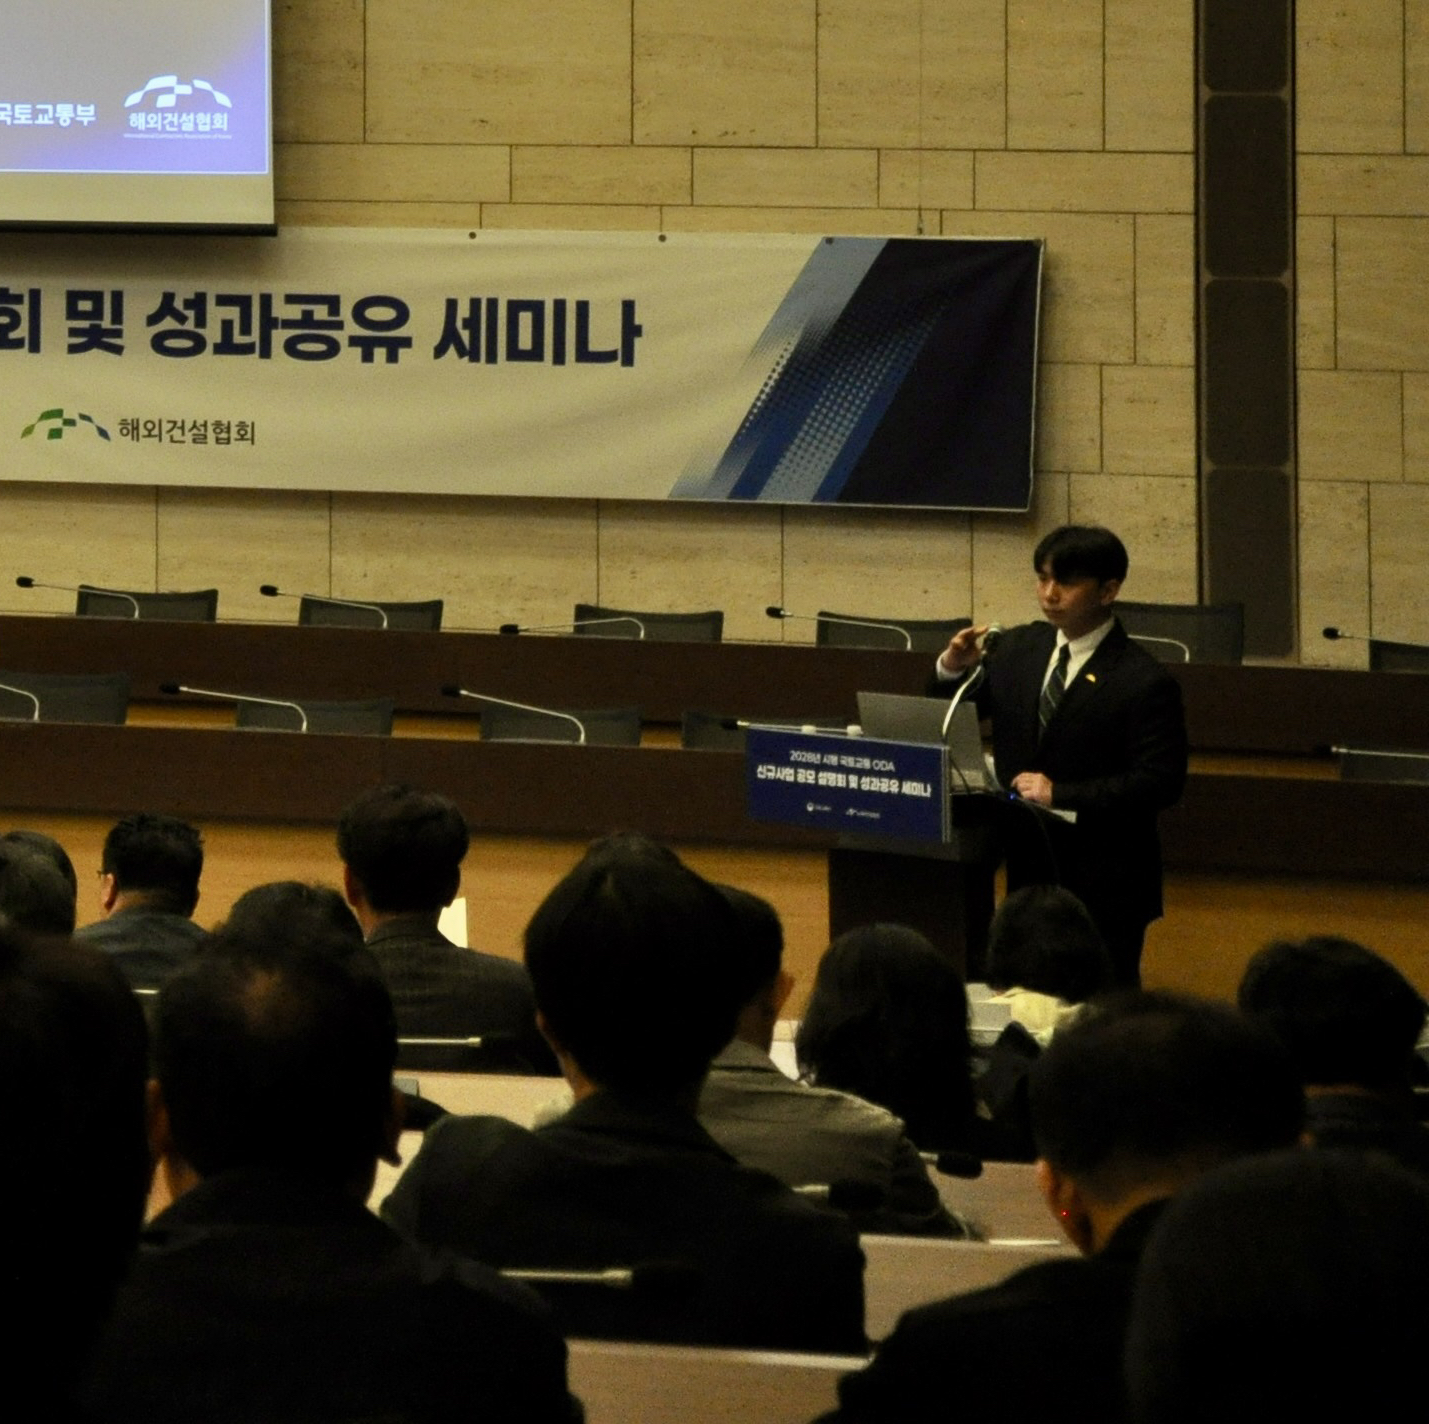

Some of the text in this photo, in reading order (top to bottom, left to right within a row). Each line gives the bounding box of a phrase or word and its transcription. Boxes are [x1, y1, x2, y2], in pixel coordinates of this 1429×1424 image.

[129, 112, 228, 132] 해외건설협회
[65, 290, 125, 356] 및
[146, 291, 412, 364] 성과공유
[433, 297, 642, 367] 세미나
[118, 418, 256, 445] 해외건설협회
[873, 759, 896, 772] ODA
[757, 764, 795, 783] 신규사업
[797, 768, 816, 784] 공모
[818, 770, 846, 787] 설명회
[860, 775, 899, 794] 성과공유
[901, 779, 932, 798] 세미나
